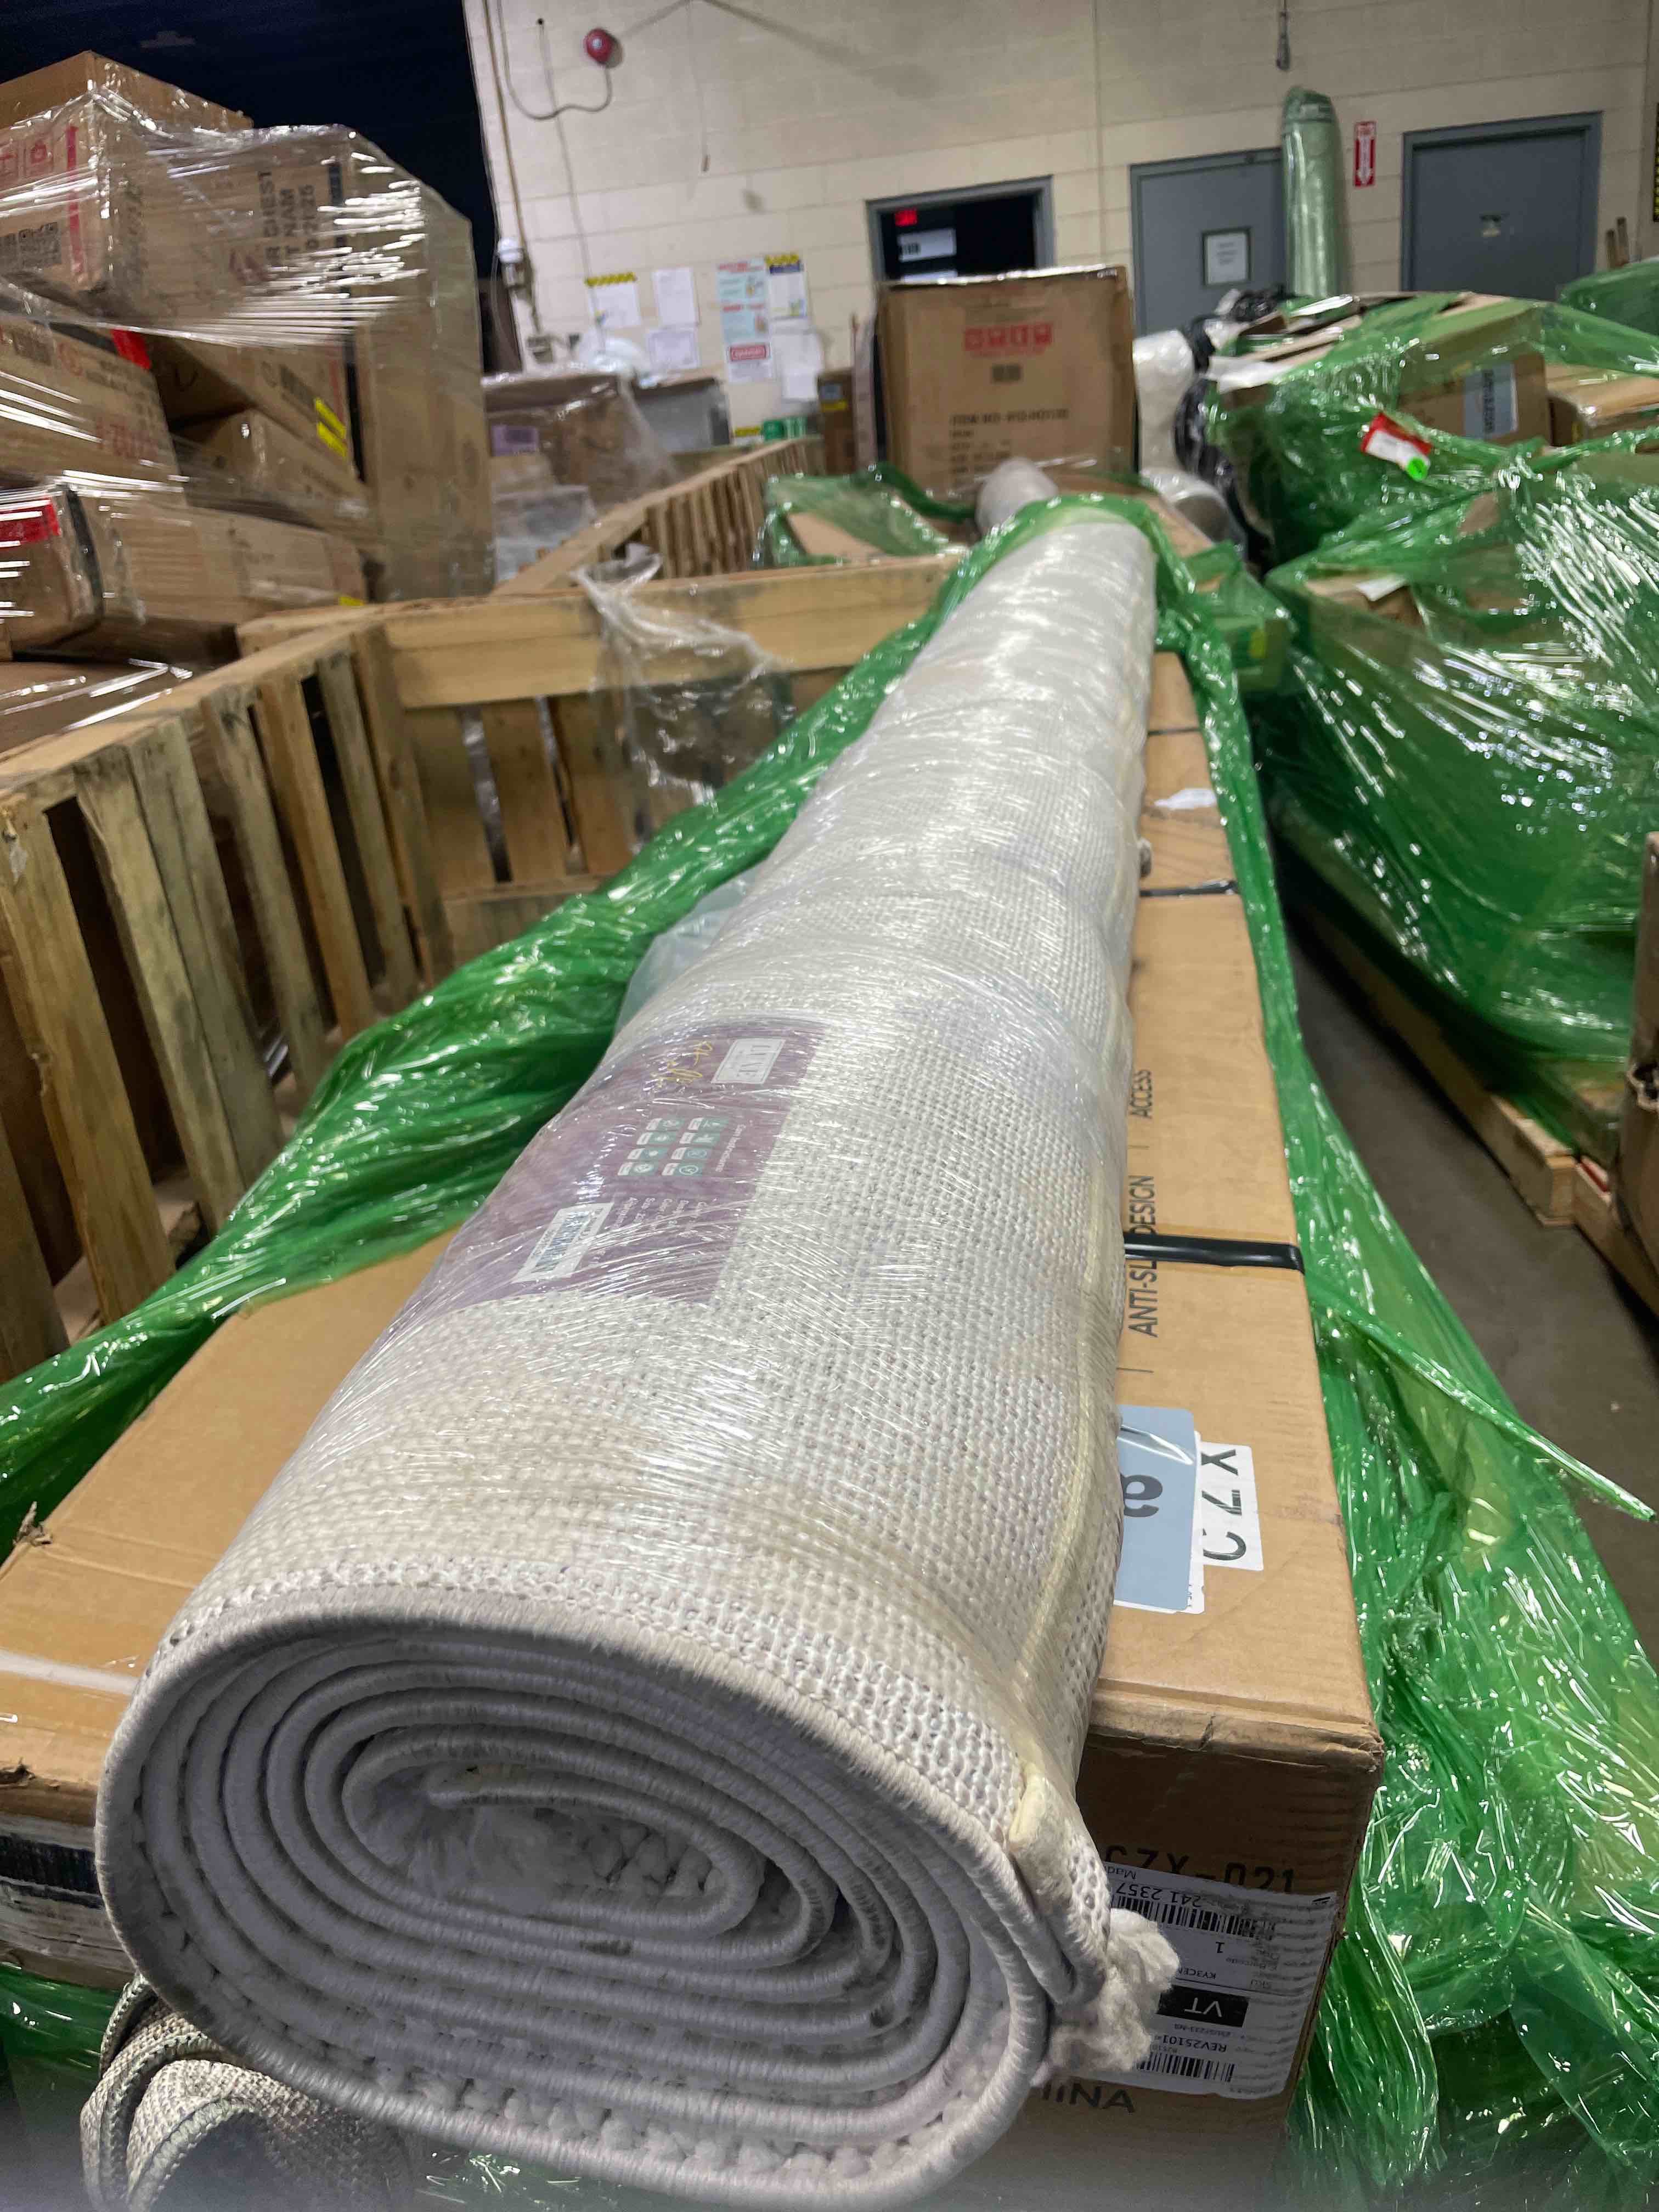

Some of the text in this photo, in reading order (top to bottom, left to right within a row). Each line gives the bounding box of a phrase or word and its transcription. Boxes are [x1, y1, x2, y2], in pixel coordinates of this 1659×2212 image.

[1128, 1175, 1158, 1338] ANTI-SL DESIGN
[1115, 1882, 1164, 1901] 2357
[1215, 1941, 1225, 1954] 1
[1183, 1997, 1222, 2018] VT
